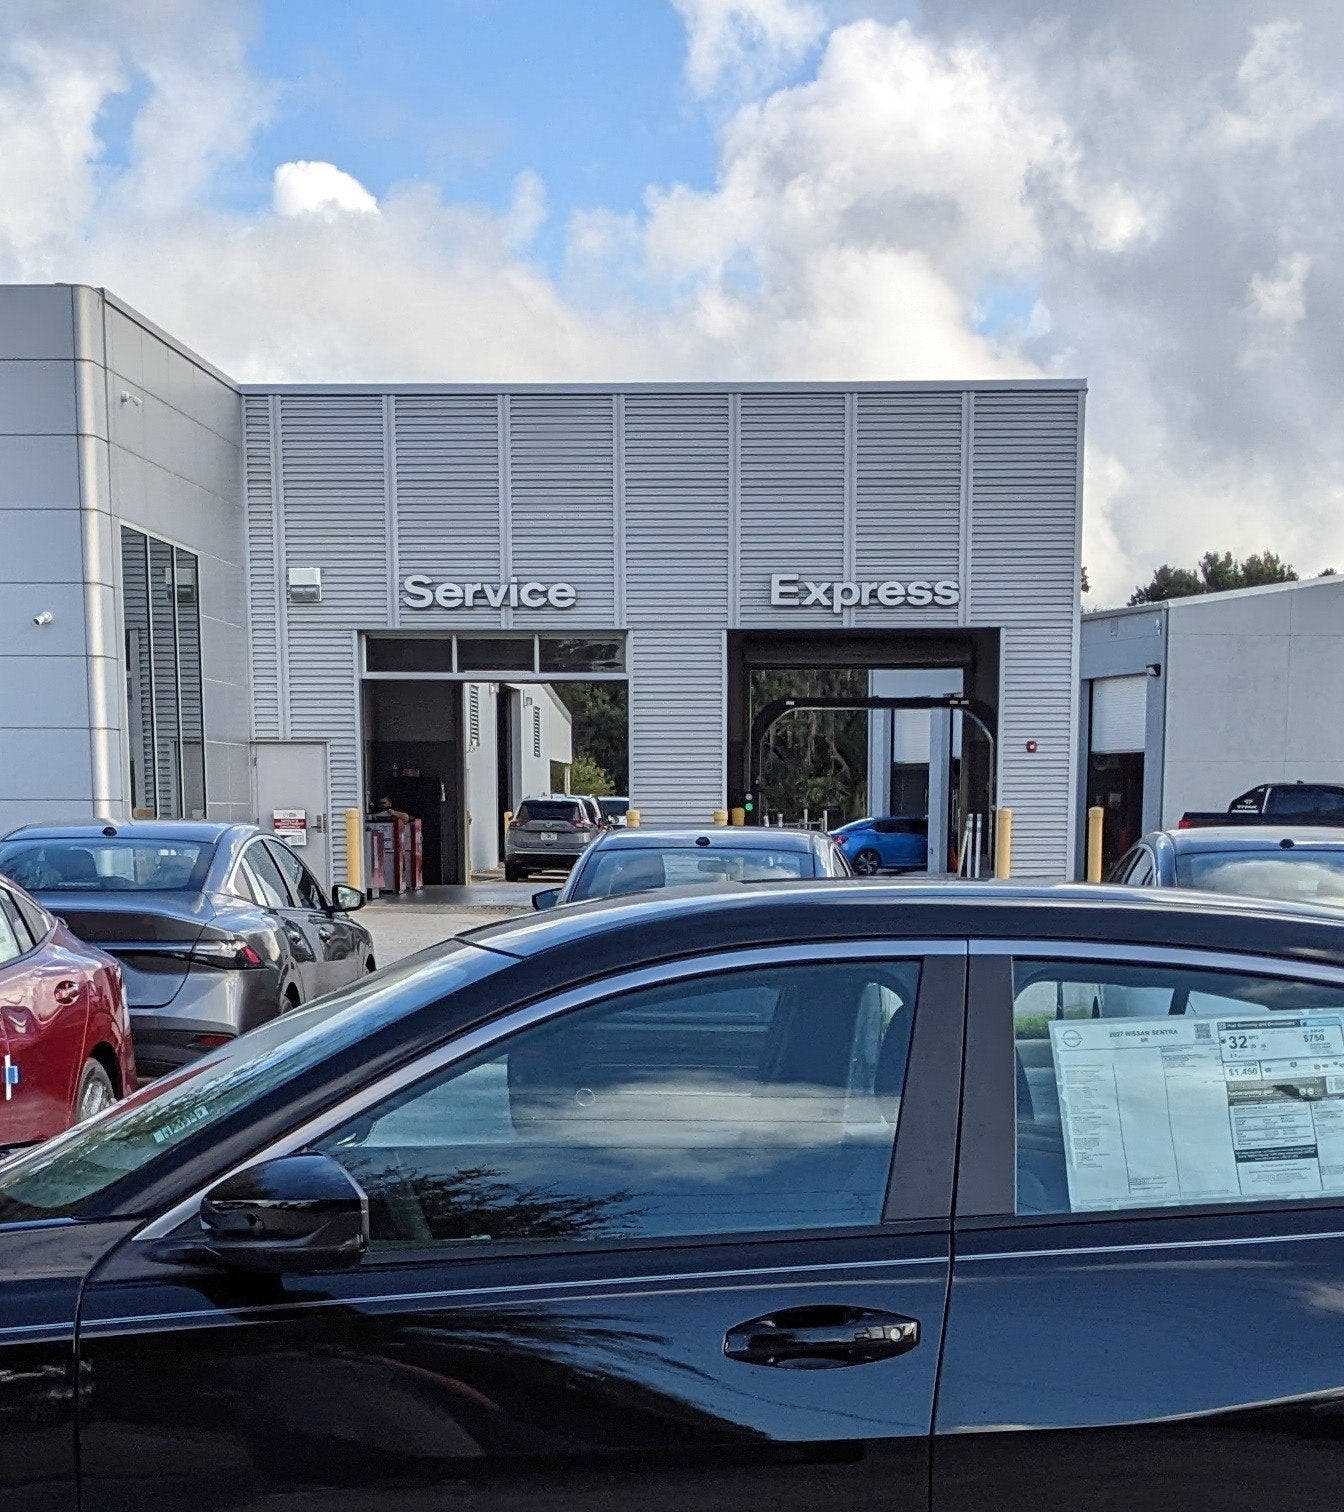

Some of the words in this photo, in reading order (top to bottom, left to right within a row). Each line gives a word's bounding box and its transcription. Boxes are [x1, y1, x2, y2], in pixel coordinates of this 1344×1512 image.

[403, 574, 577, 609] Service
[771, 573, 960, 614] Express
[1151, 1028, 1178, 1036] SENTRA
[1228, 1035, 1248, 1050] 32
